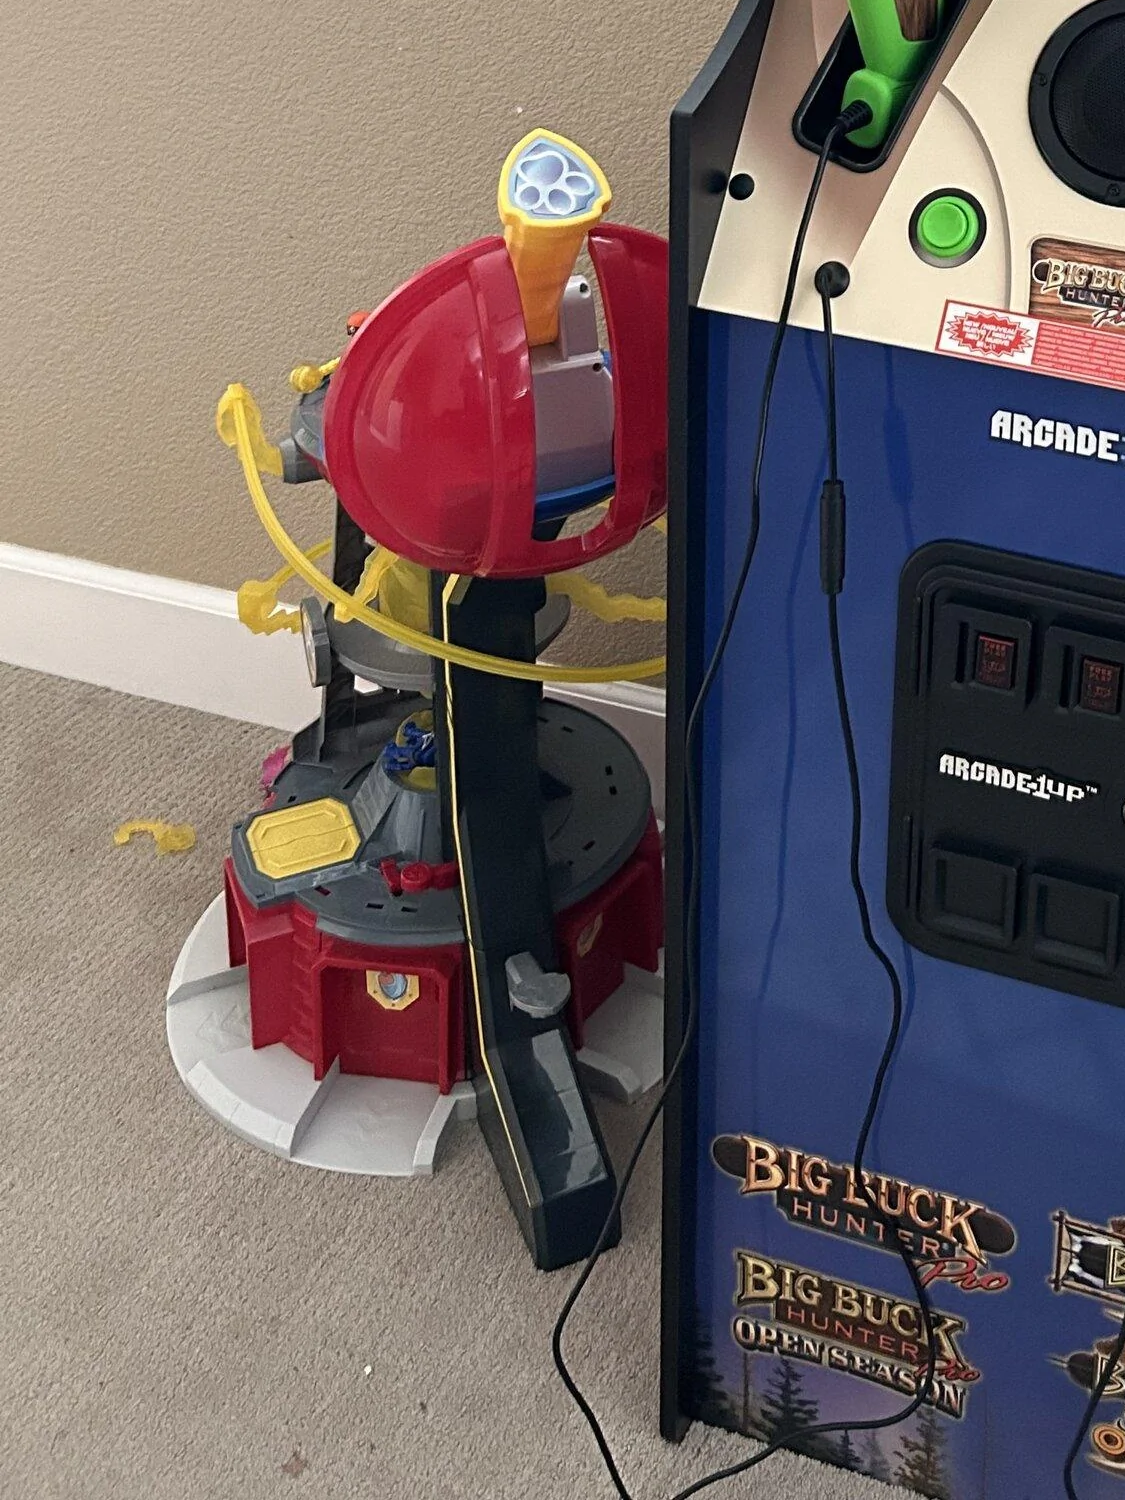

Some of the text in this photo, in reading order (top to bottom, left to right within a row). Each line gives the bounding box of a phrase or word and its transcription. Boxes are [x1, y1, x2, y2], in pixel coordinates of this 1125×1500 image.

[1043, 259, 1088, 291] BIG
[740, 1135, 988, 1268] BIG BUCK
[915, 1257, 1010, 1291] Pro
[737, 1252, 968, 1371] BIG BUCK
[787, 1305, 919, 1361] HUNTER
[734, 1315, 822, 1360] OPEN
